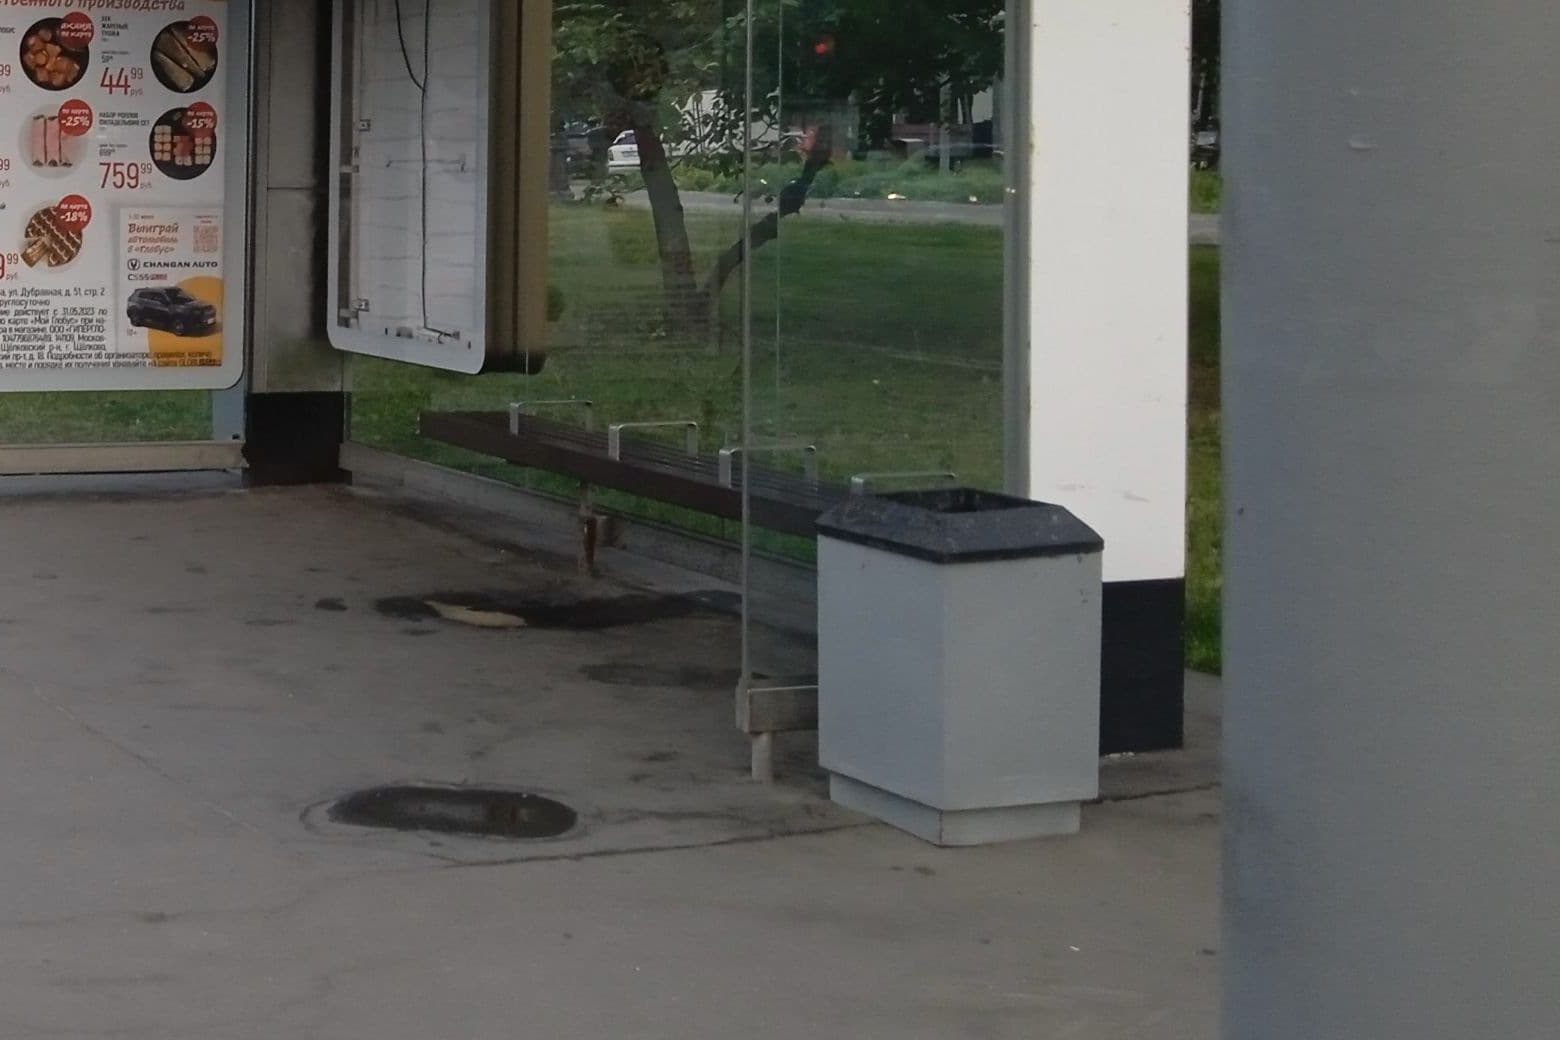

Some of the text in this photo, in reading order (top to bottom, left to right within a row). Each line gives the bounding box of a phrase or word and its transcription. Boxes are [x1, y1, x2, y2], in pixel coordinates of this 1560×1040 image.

[100, 67, 143, 95] 44 99
[61, 116, 90, 127] -25%
[186, 118, 215, 129] -15%
[99, 162, 153, 189] 759 99
[60, 211, 89, 222] -18%
[128, 222, 179, 235] Выиграй
[7, 253, 19, 265] 99
[100, 287, 105, 296] 2
